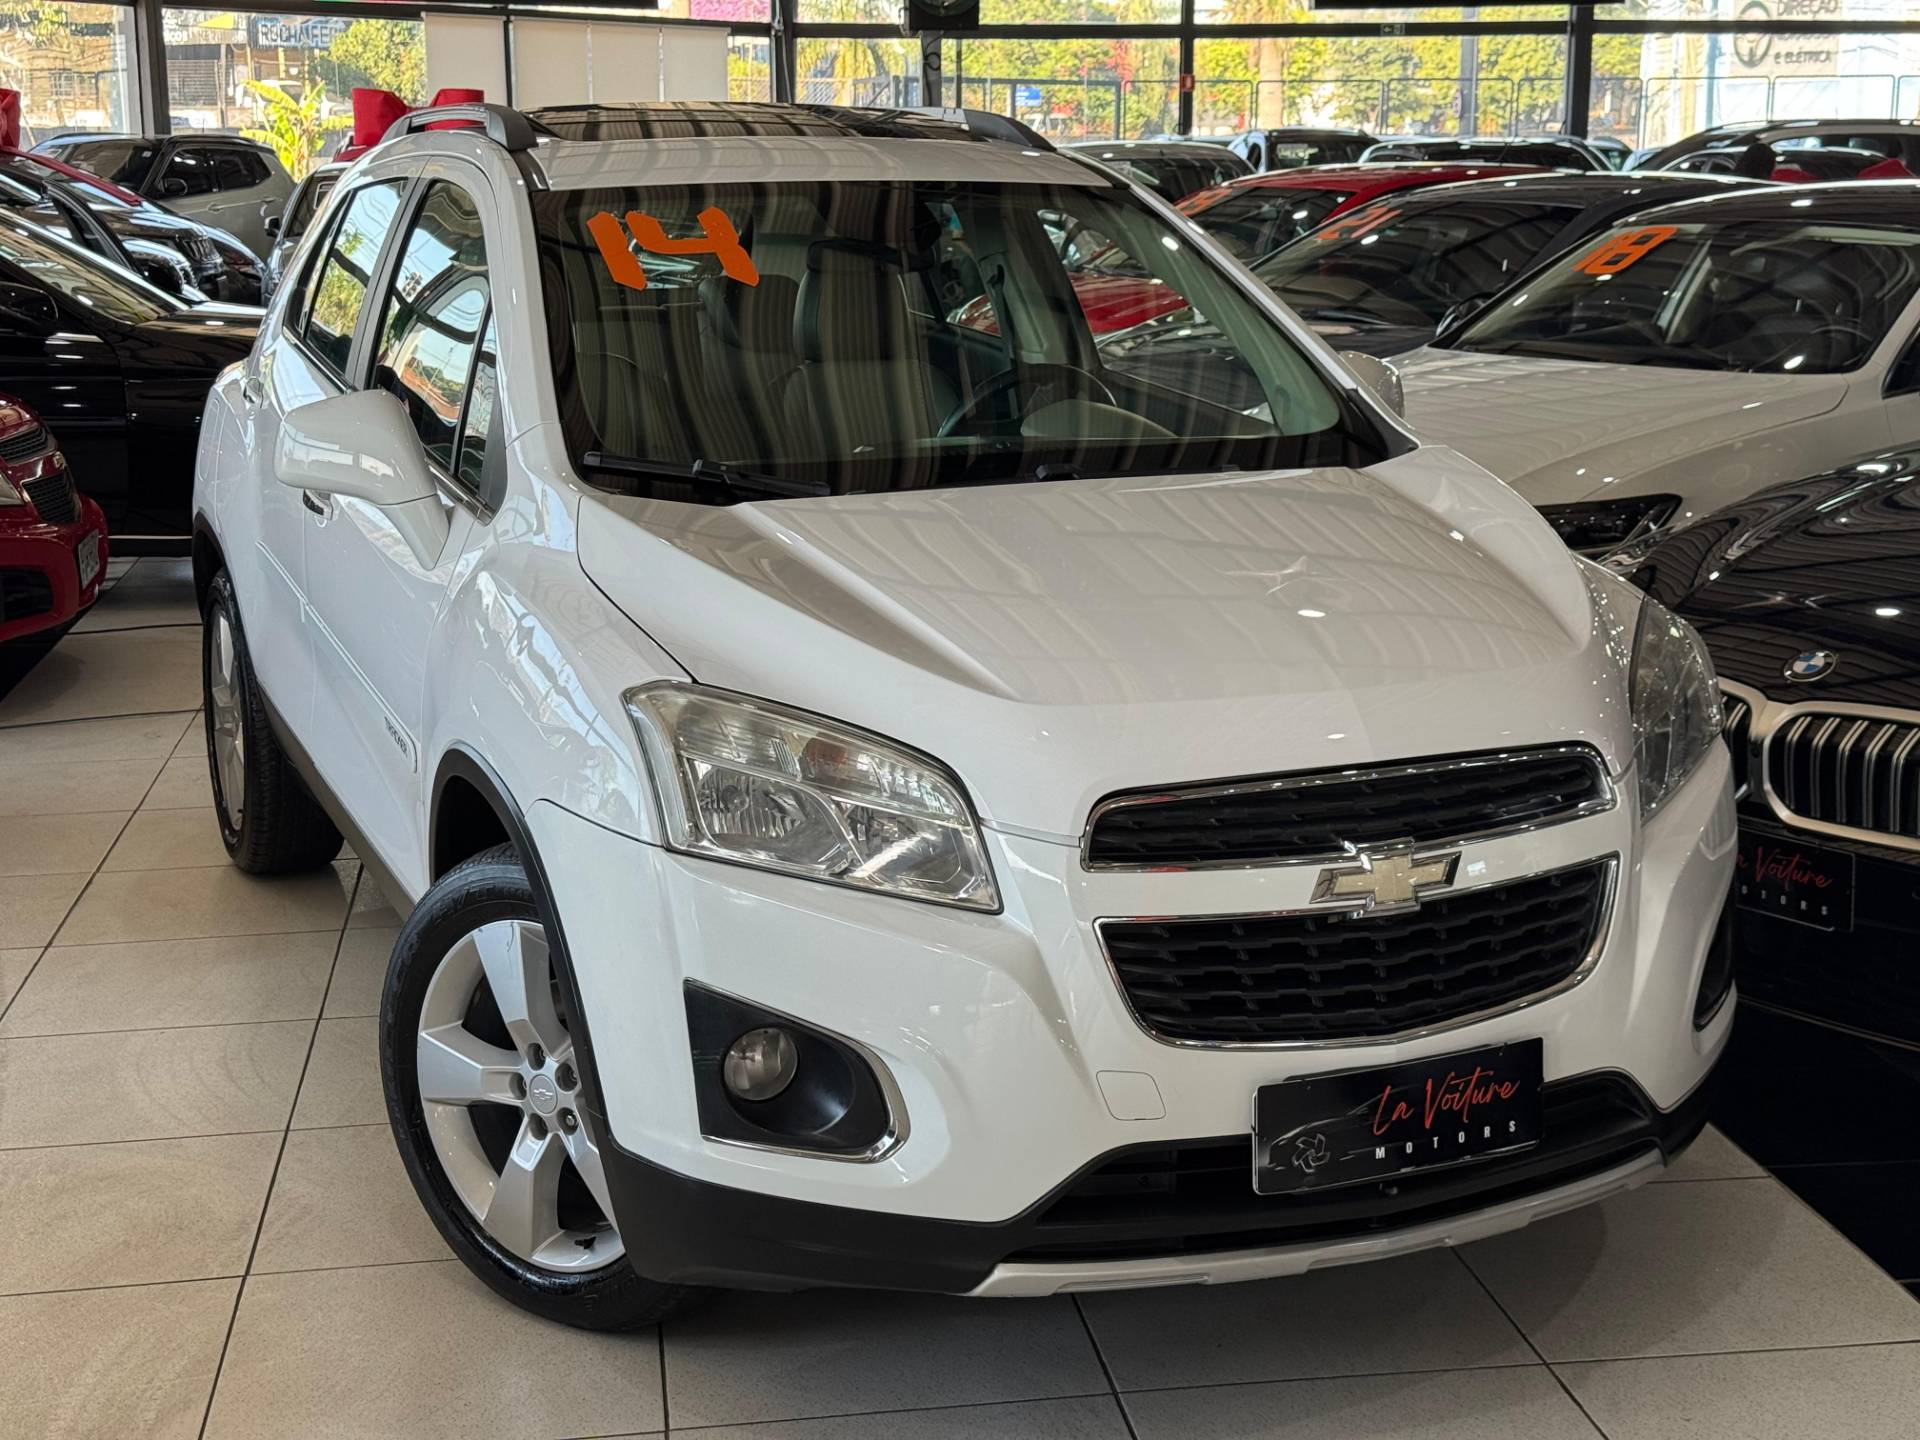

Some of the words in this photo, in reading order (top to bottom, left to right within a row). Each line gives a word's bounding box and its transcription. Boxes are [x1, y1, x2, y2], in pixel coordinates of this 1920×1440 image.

[586, 206, 760, 291] 14
[1572, 226, 1678, 275] 18
[1754, 846, 1834, 892] Voiture
[1741, 885, 1829, 916] OTORS
[1372, 1085, 1415, 1136] La
[1424, 1066, 1521, 1130] Voiture
[1375, 1120, 1516, 1160] MOTORS
